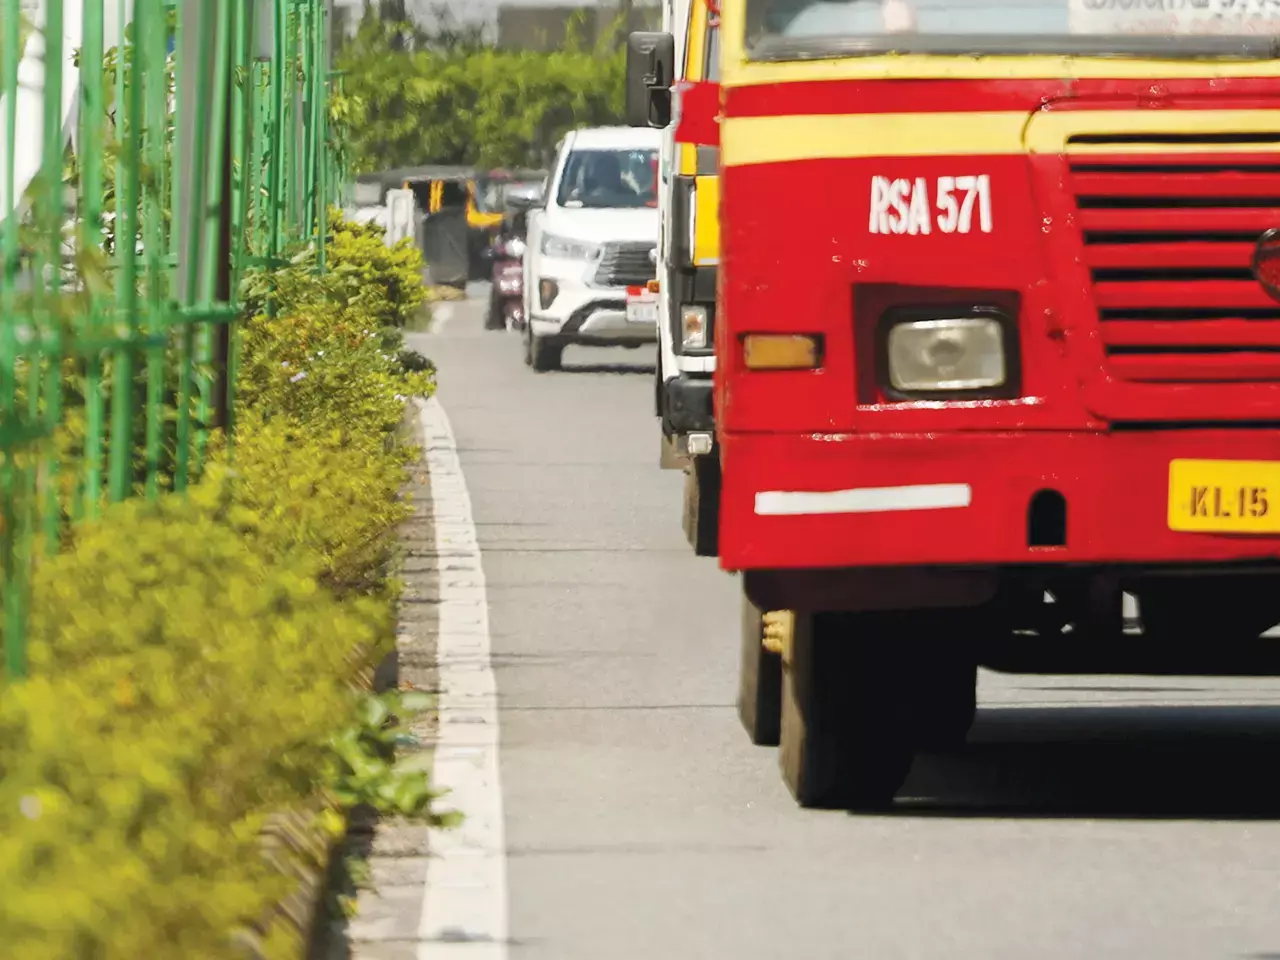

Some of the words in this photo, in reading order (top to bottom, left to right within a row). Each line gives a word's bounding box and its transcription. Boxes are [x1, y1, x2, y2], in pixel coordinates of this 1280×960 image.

[869, 175, 932, 235] RSA
[936, 174, 993, 234] 571
[1190, 486, 1269, 518] KL15
